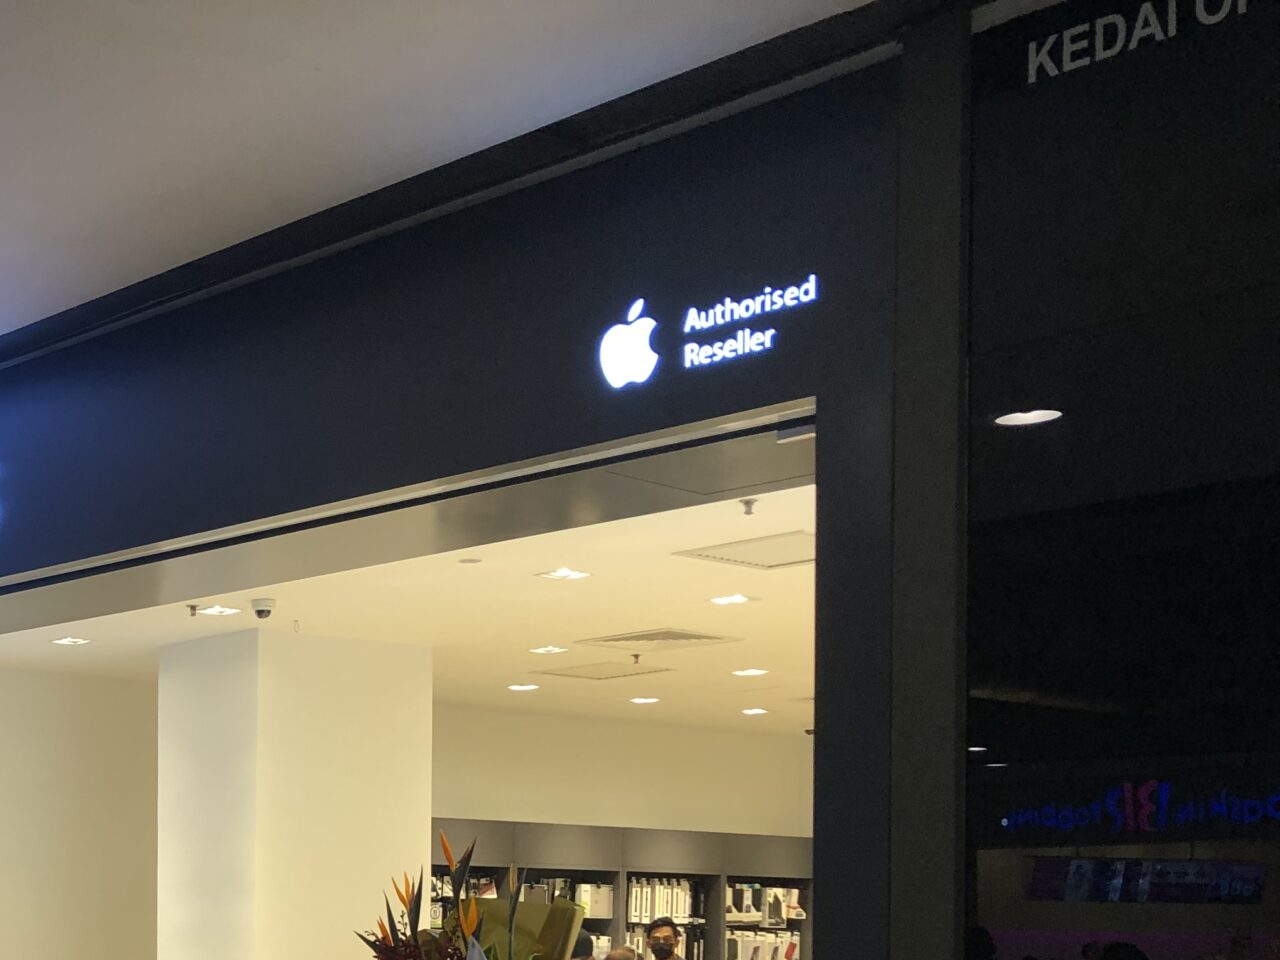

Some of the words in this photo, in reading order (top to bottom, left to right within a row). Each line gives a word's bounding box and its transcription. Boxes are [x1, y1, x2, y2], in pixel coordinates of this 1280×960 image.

[1027, 0, 1177, 84] KEDAI
[683, 273, 817, 334] Authorised
[683, 328, 777, 368] Reseller
